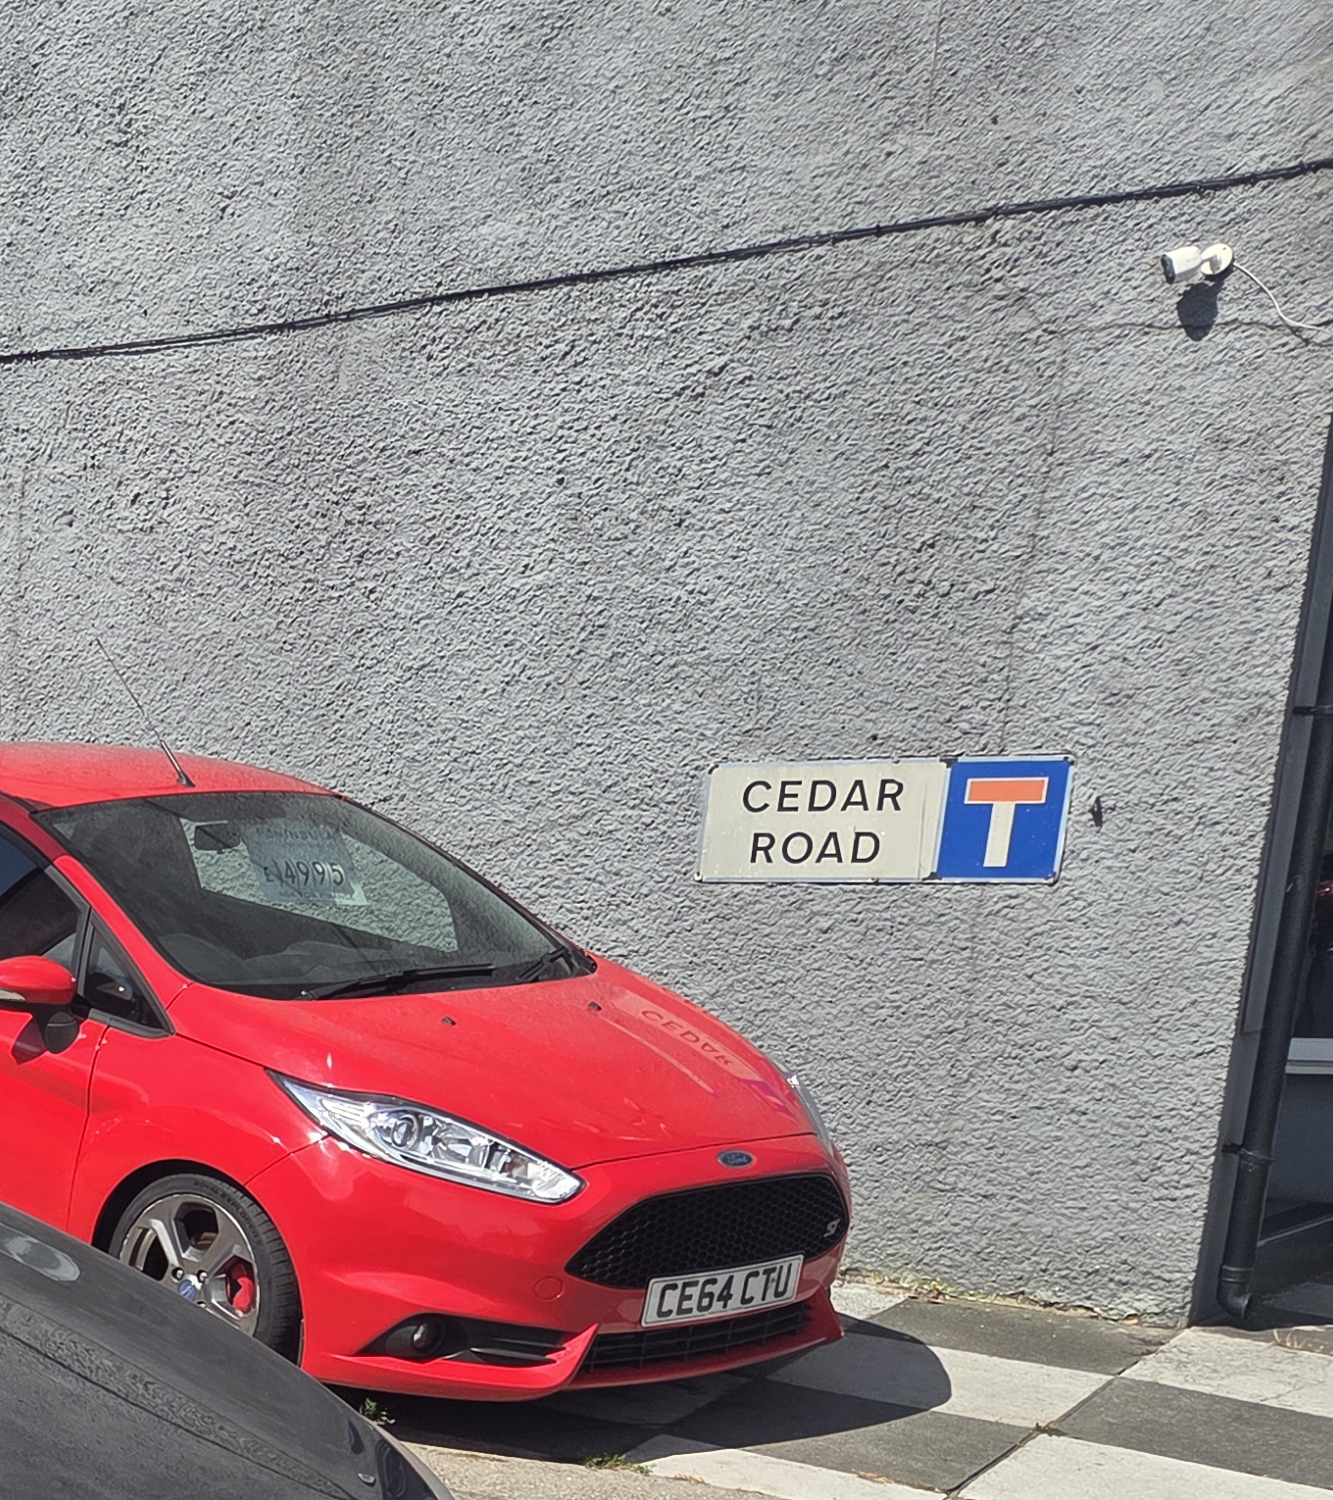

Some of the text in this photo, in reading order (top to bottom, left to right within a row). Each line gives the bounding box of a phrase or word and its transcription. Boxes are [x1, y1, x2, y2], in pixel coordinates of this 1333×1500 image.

[742, 778, 904, 812] CEDAR
[749, 831, 881, 865] ROAD
[656, 1262, 793, 1319] CE64 CTU
